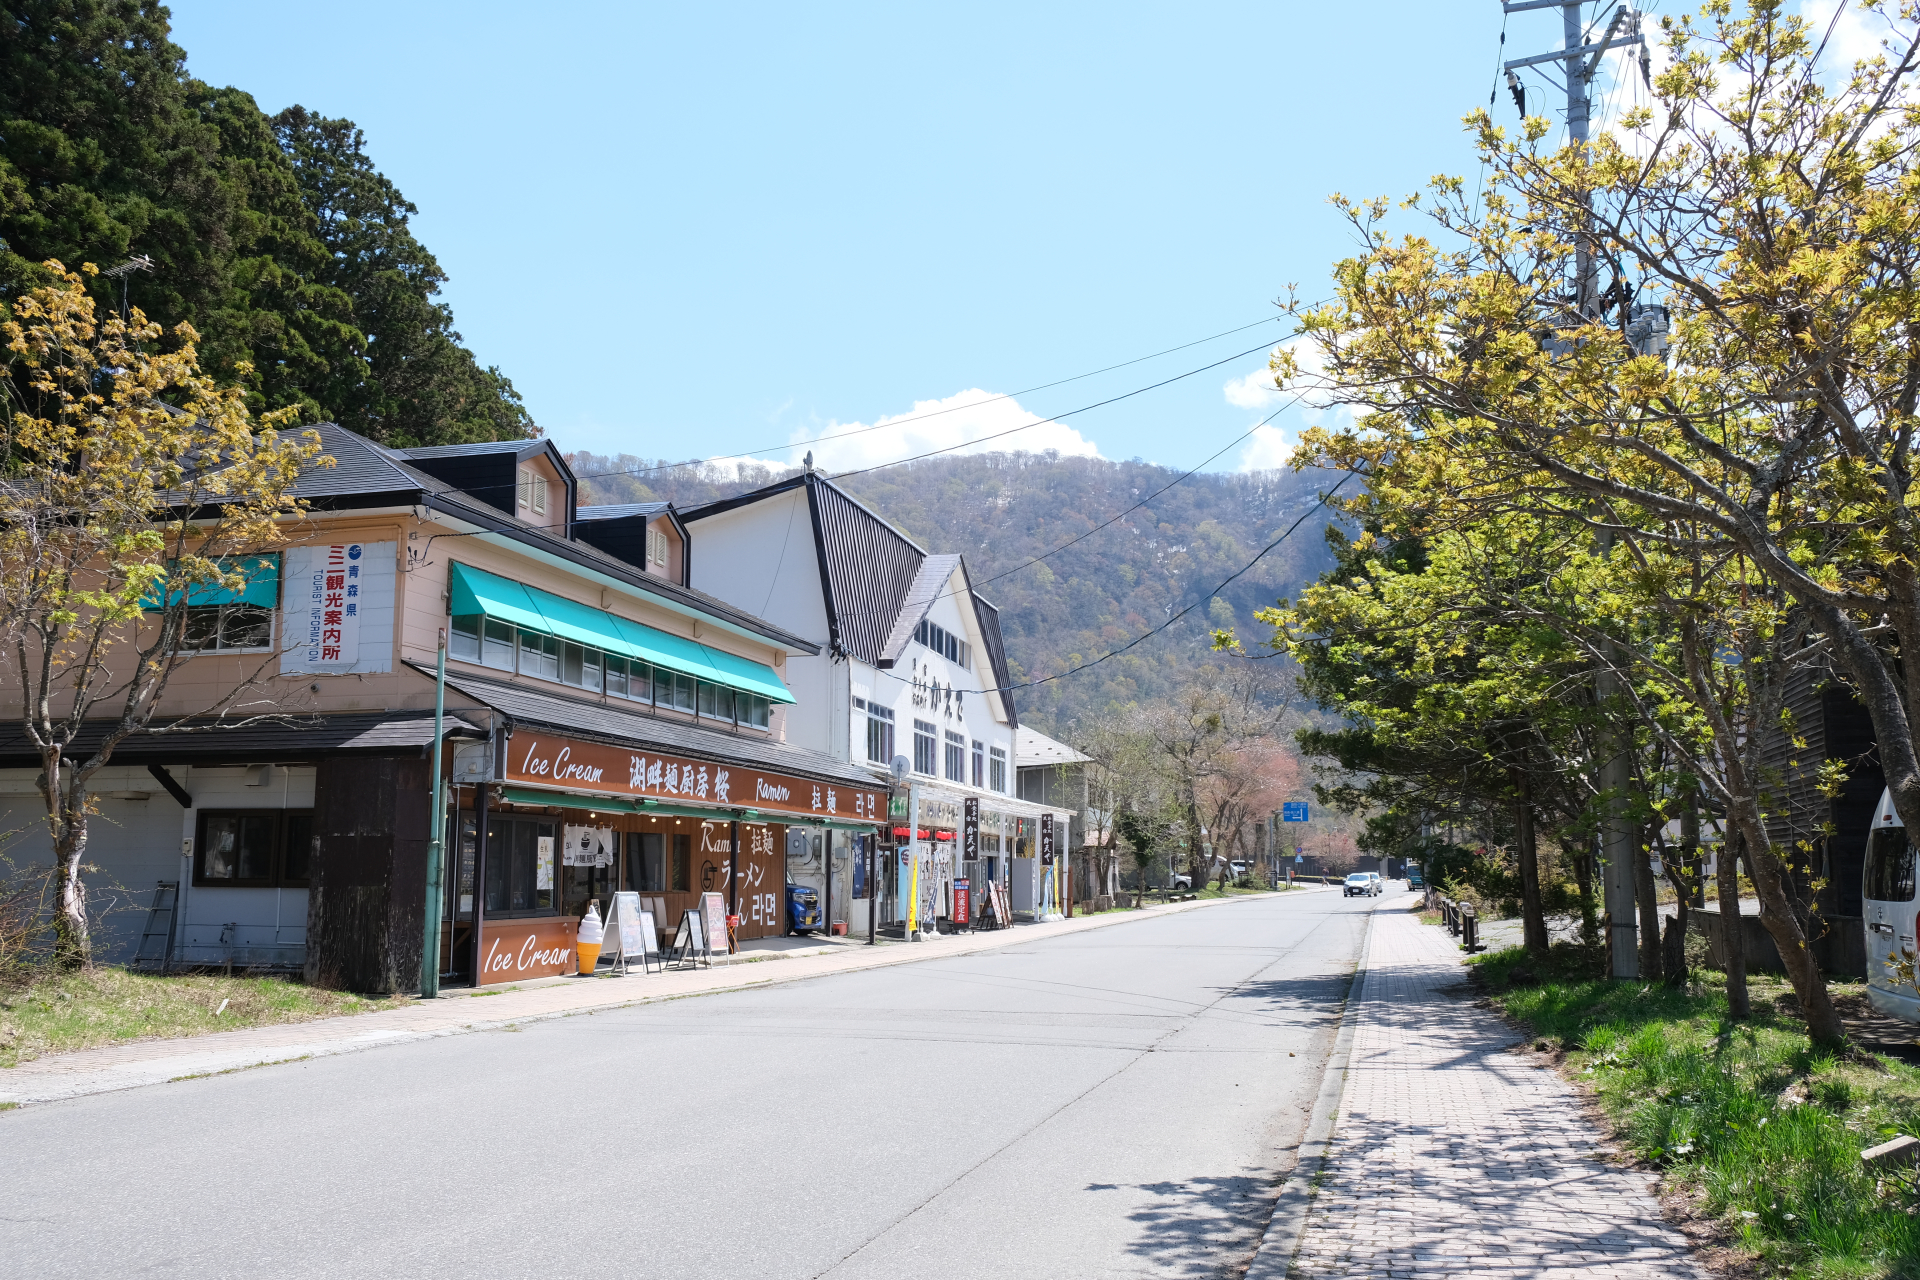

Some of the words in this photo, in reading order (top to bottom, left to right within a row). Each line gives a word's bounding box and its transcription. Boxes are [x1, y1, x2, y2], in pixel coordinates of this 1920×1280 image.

[311, 569, 324, 604] TOURIST
[321, 545, 345, 661] ミニ観光案内所
[345, 565, 359, 617] 青森県
[308, 607, 322, 662] INFORMATION
[522, 741, 550, 775] Ice
[553, 746, 604, 783] Cream
[755, 777, 790, 802] Ramen
[811, 784, 837, 814] 拉麺
[855, 792, 876, 819] 라면
[701, 823, 741, 853] Ramn
[751, 827, 774, 855] 拉麺
[721, 859, 766, 890] ラーメン
[752, 892, 776, 926] 라면
[484, 937, 514, 974] Ice
[517, 934, 571, 971] Cream
